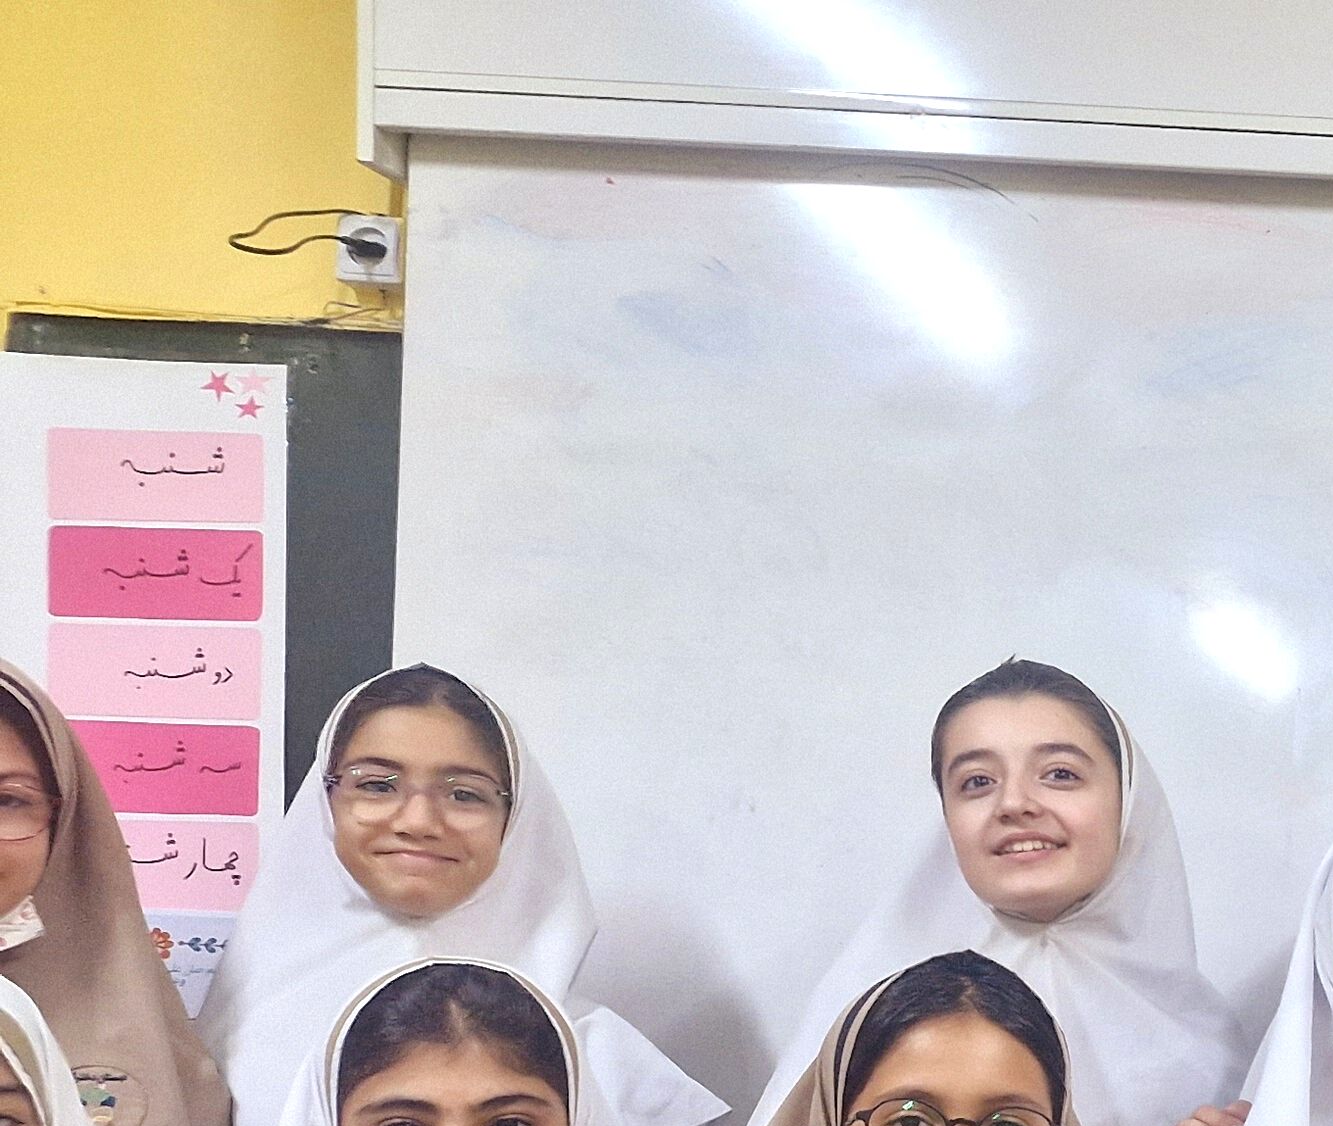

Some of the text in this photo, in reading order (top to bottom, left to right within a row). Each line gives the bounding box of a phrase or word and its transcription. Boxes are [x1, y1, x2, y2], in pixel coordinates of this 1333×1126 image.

[120, 447, 225, 487] شنبه
[103, 543, 254, 598] یک شنبه
[124, 647, 234, 690] دو شنبه
[113, 740, 242, 784] سه شنبه
[183, 837, 242, 886] چهار
